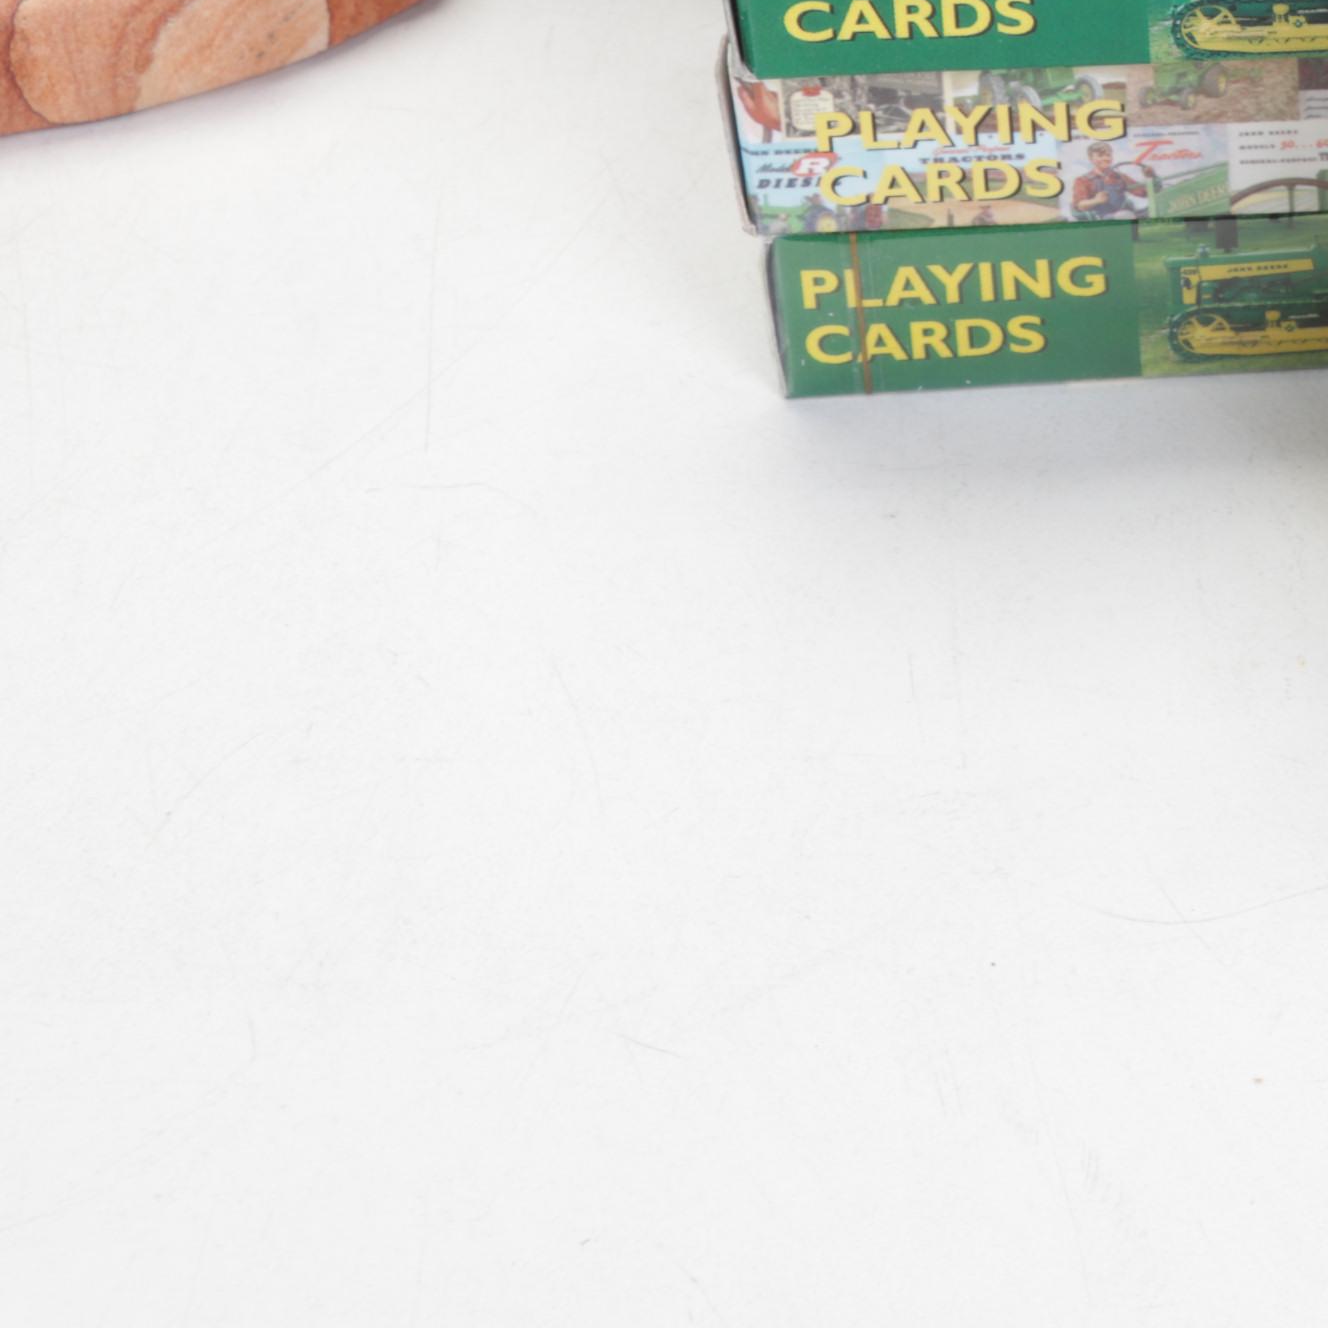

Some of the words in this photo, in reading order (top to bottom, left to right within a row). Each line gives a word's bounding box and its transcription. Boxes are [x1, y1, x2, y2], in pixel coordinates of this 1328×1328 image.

[814, 99, 1128, 152] PLAYING
[821, 159, 1064, 207] CARDS
[799, 256, 1108, 310] PLAYING
[804, 315, 1048, 365] CARDS
